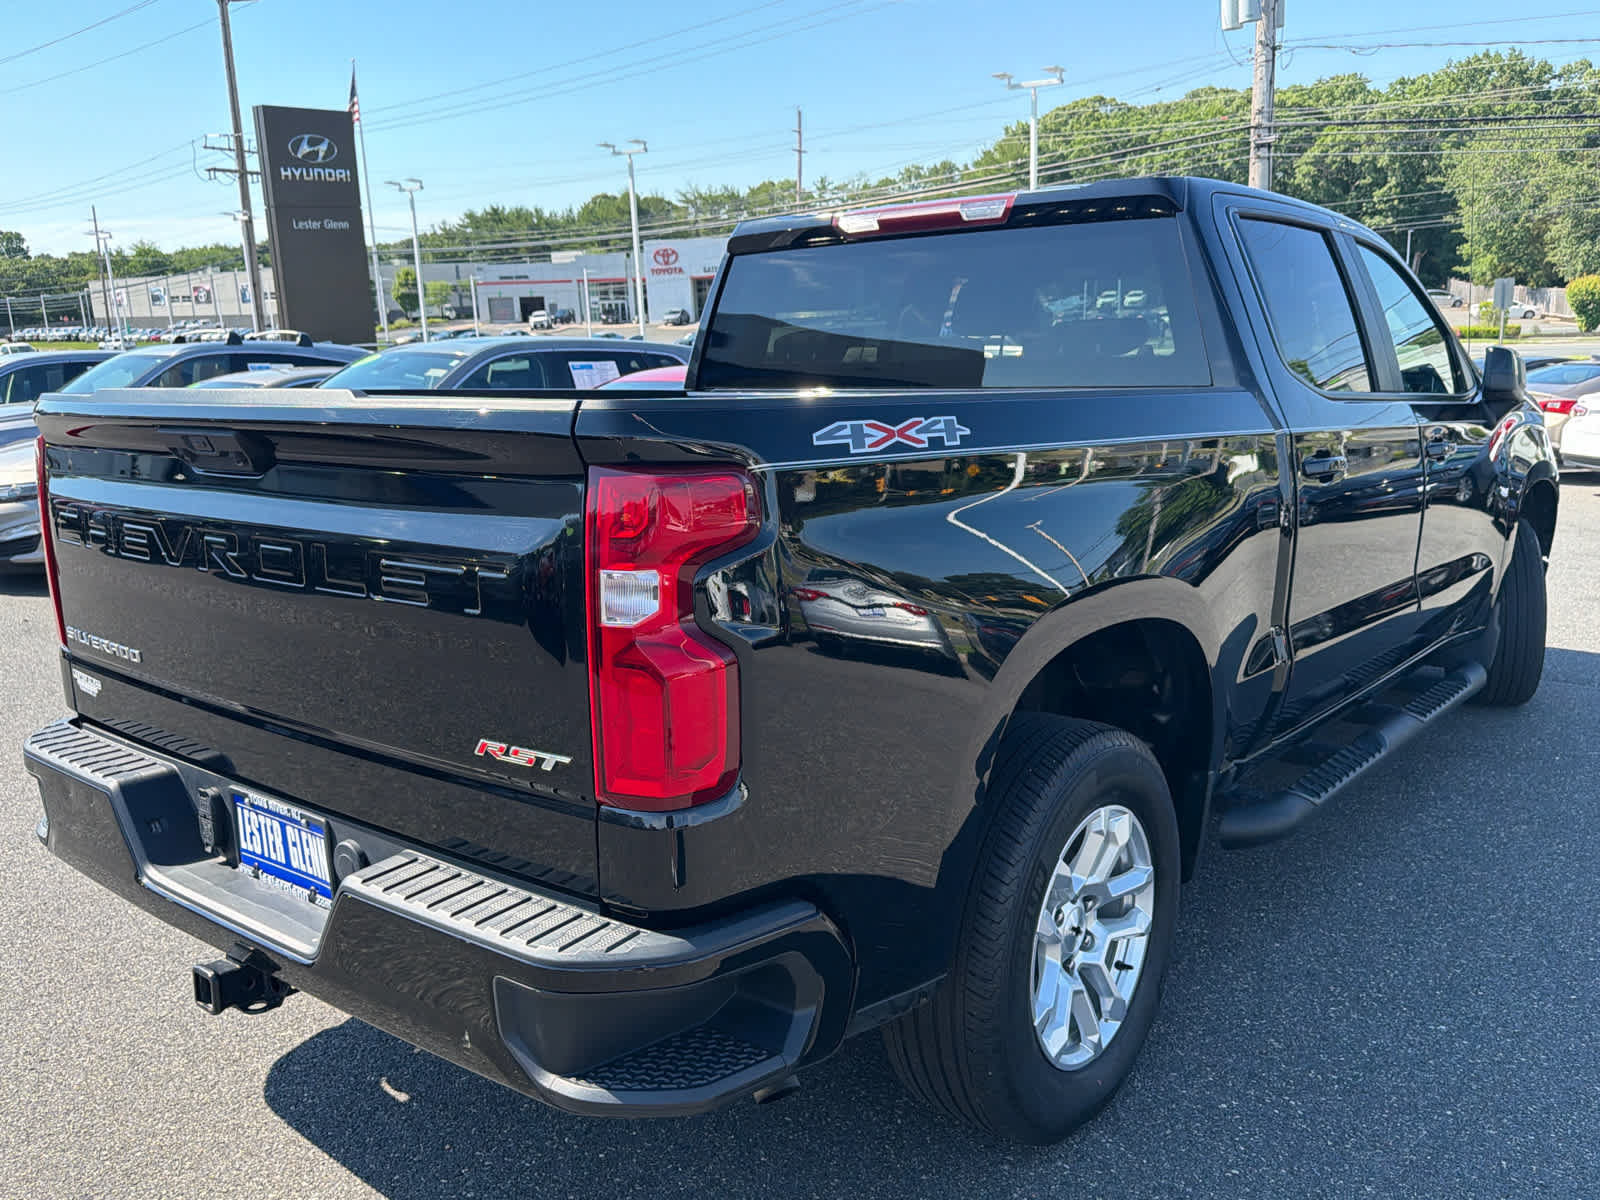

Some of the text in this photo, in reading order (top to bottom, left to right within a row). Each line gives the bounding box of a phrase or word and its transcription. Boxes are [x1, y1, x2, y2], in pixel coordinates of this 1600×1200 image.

[280, 166, 351, 183] HYUNDAI
[292, 218, 350, 230] Lester Glenn
[650, 267, 684, 276] TOYOTA
[52, 498, 511, 616] CHEVROLET
[66, 625, 142, 663] SILVERADO
[474, 739, 572, 771] RST
[237, 807, 331, 884] LESTER GLENN
